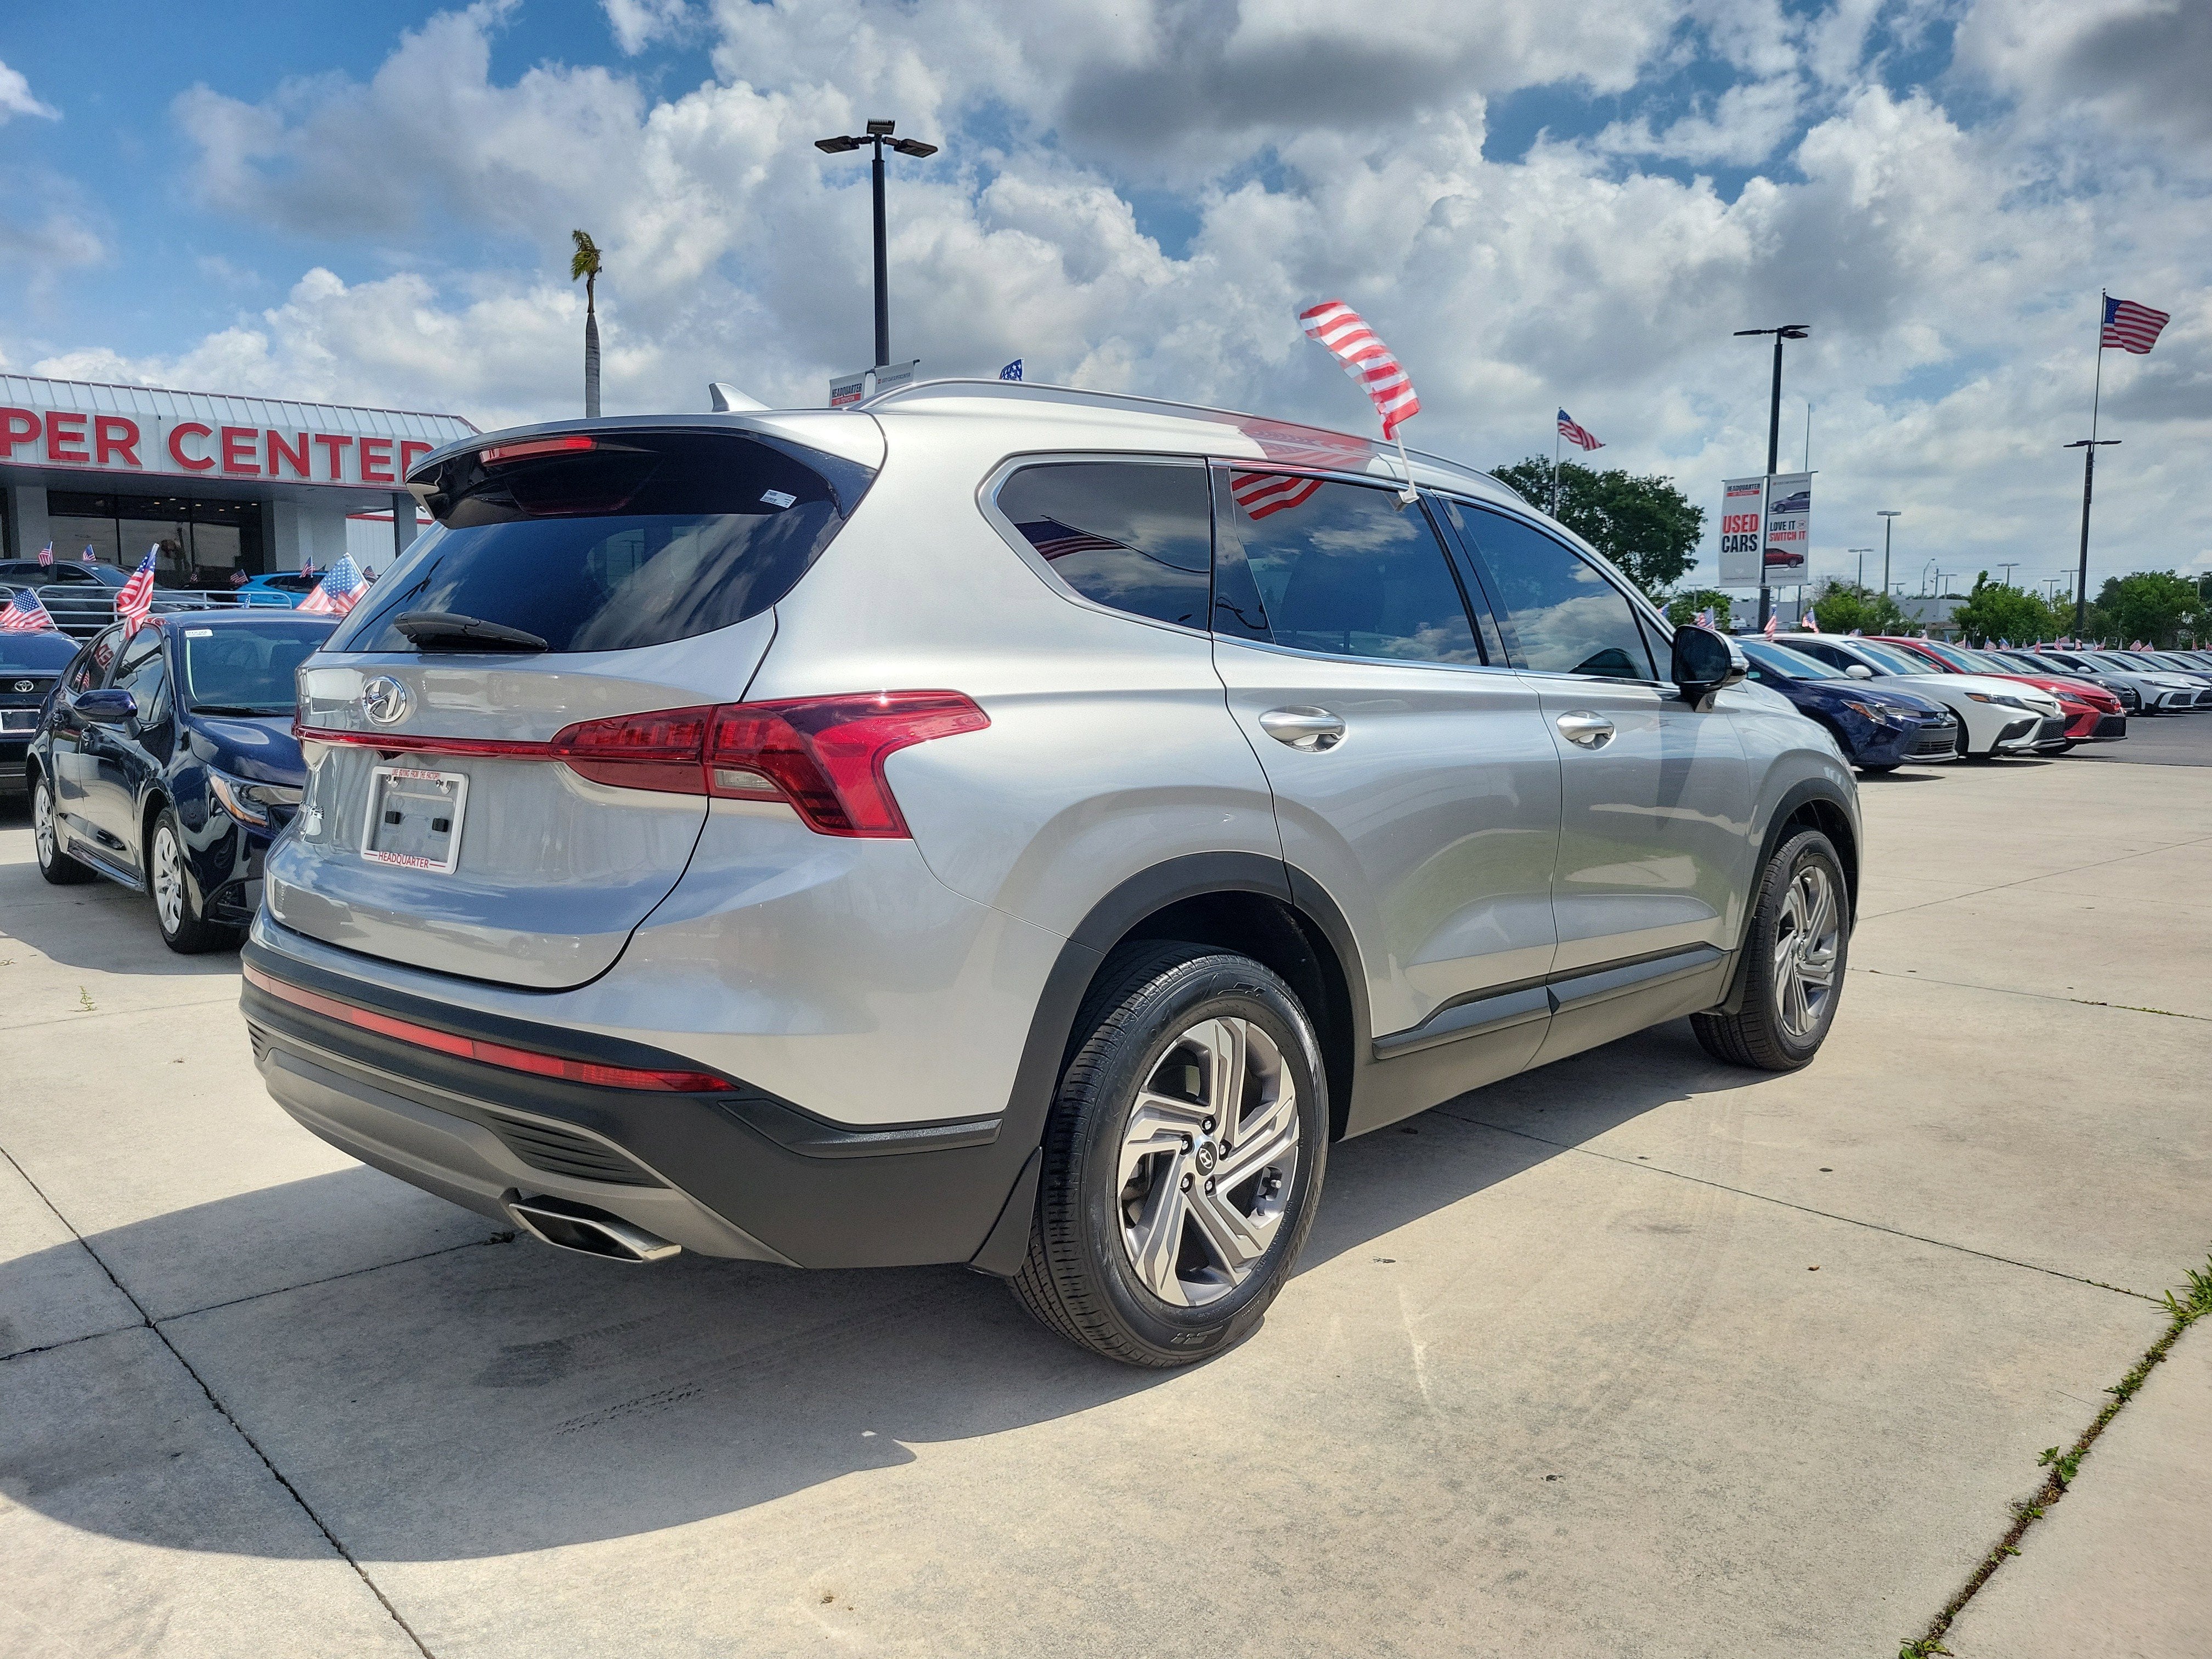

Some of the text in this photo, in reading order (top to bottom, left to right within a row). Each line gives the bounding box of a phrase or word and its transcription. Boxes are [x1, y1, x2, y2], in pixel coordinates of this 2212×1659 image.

[832, 383, 862, 398] HEADQUARTER
[1723, 514, 1759, 534] USED
[1770, 521, 1786, 531] LOVE
[1788, 521, 1796, 531] IT
[1721, 534, 1758, 554] CARS
[1769, 531, 1806, 541] SWITCH IT
[378, 851, 429, 868] HEADQUARTER
